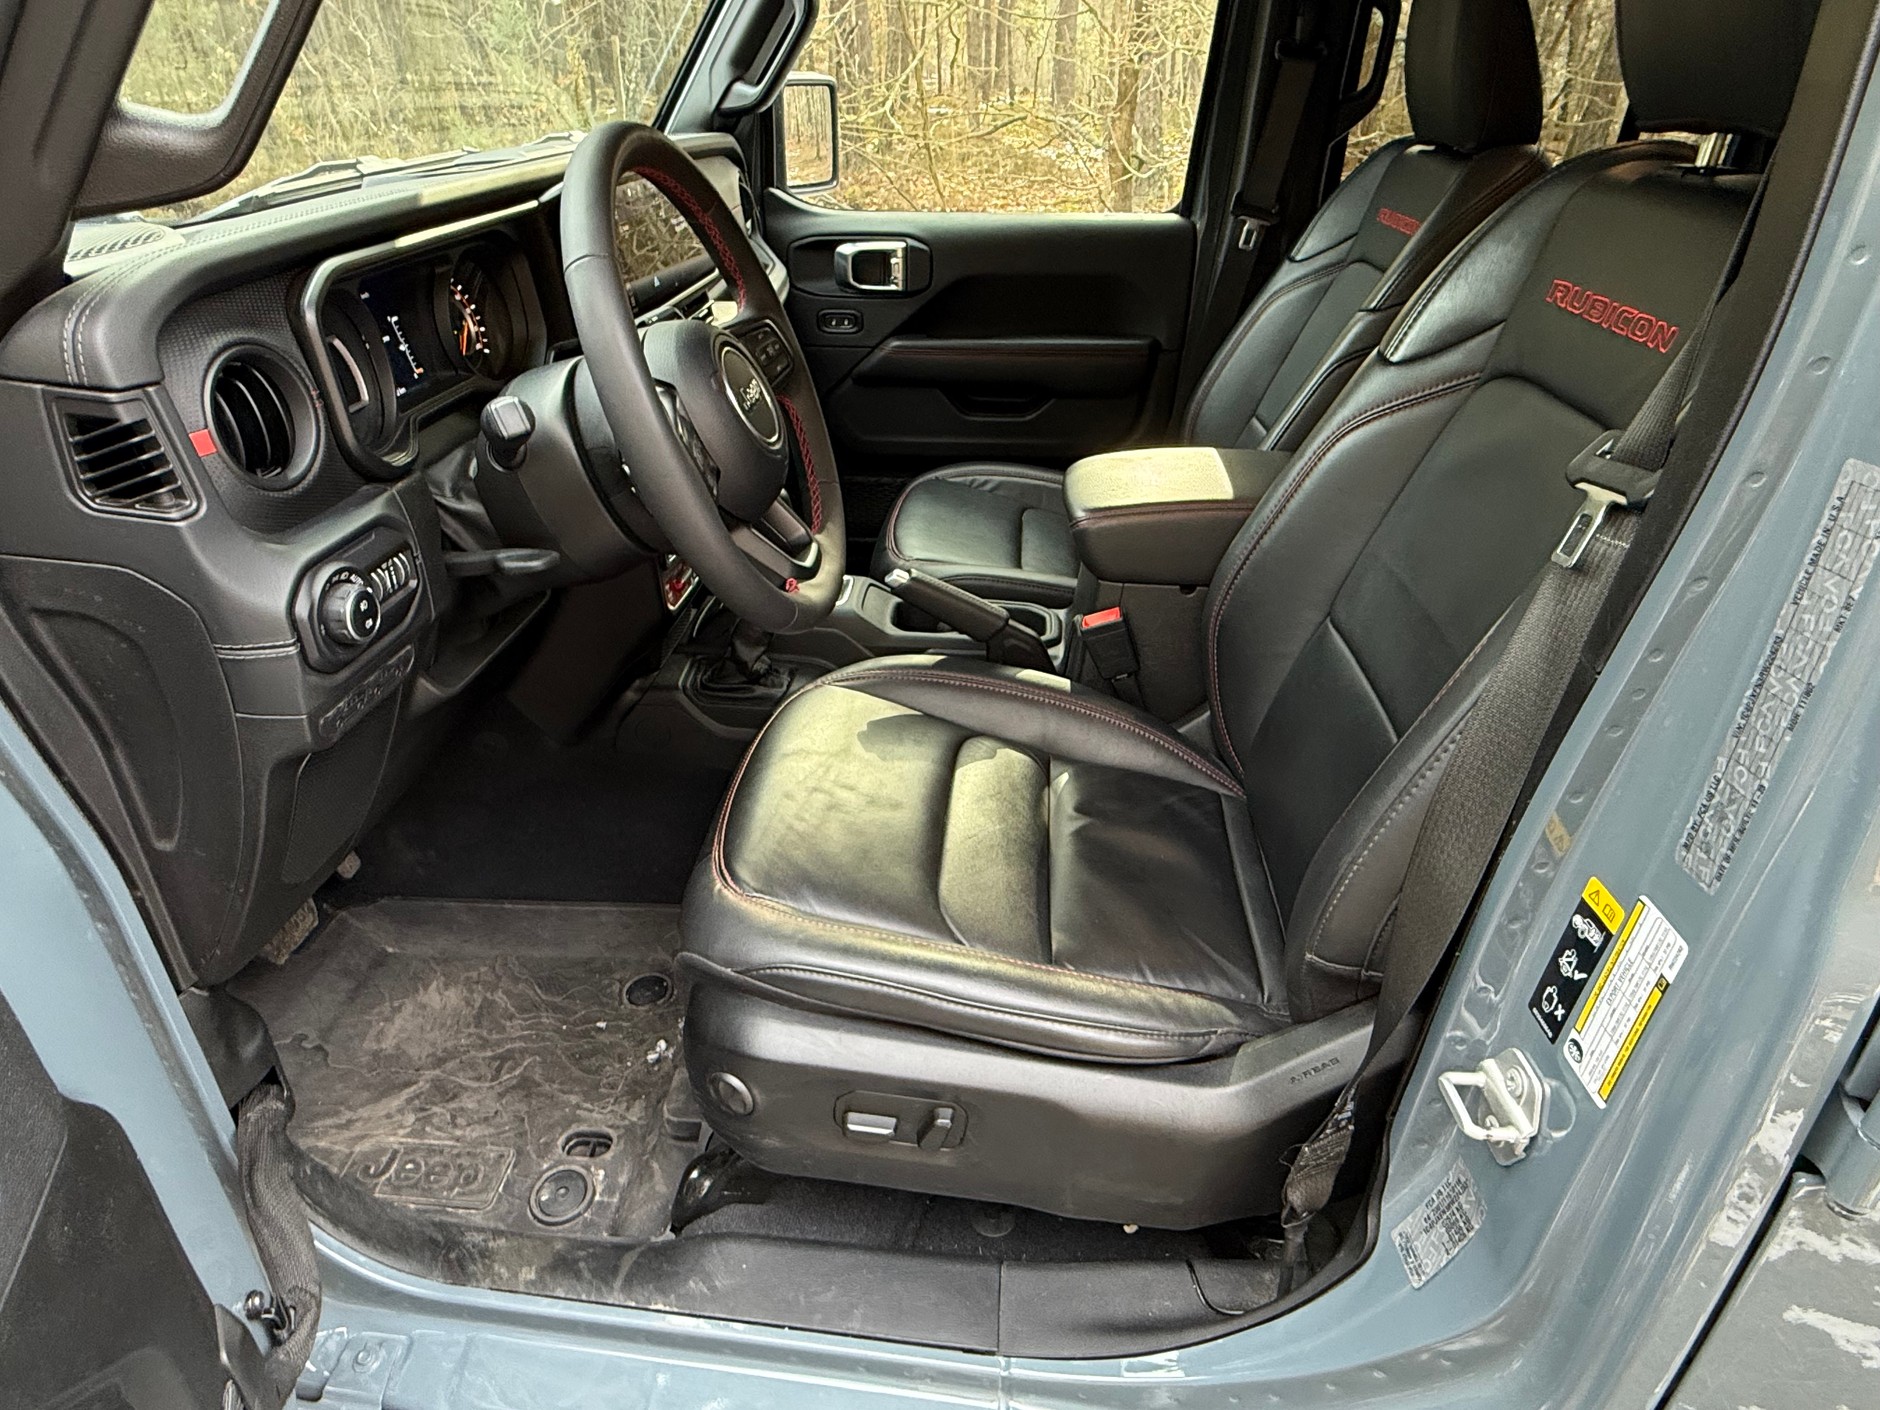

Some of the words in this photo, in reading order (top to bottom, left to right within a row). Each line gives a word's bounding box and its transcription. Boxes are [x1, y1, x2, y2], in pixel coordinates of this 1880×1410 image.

[1546, 279, 1679, 353] RUBICON
[1791, 568, 1812, 607] VEHICLE
[1808, 540, 1825, 568] MADE
[1821, 526, 1831, 539] IN
[1696, 803, 1708, 819] FCA
[1704, 791, 1714, 803] US
[1709, 776, 1721, 790] LLC
[1714, 864, 1726, 881] DATE
[1604, 982, 1620, 1006] EXPORT
[1619, 958, 1633, 982] VEHICLE
[356, 1148, 484, 1199] Jeep
